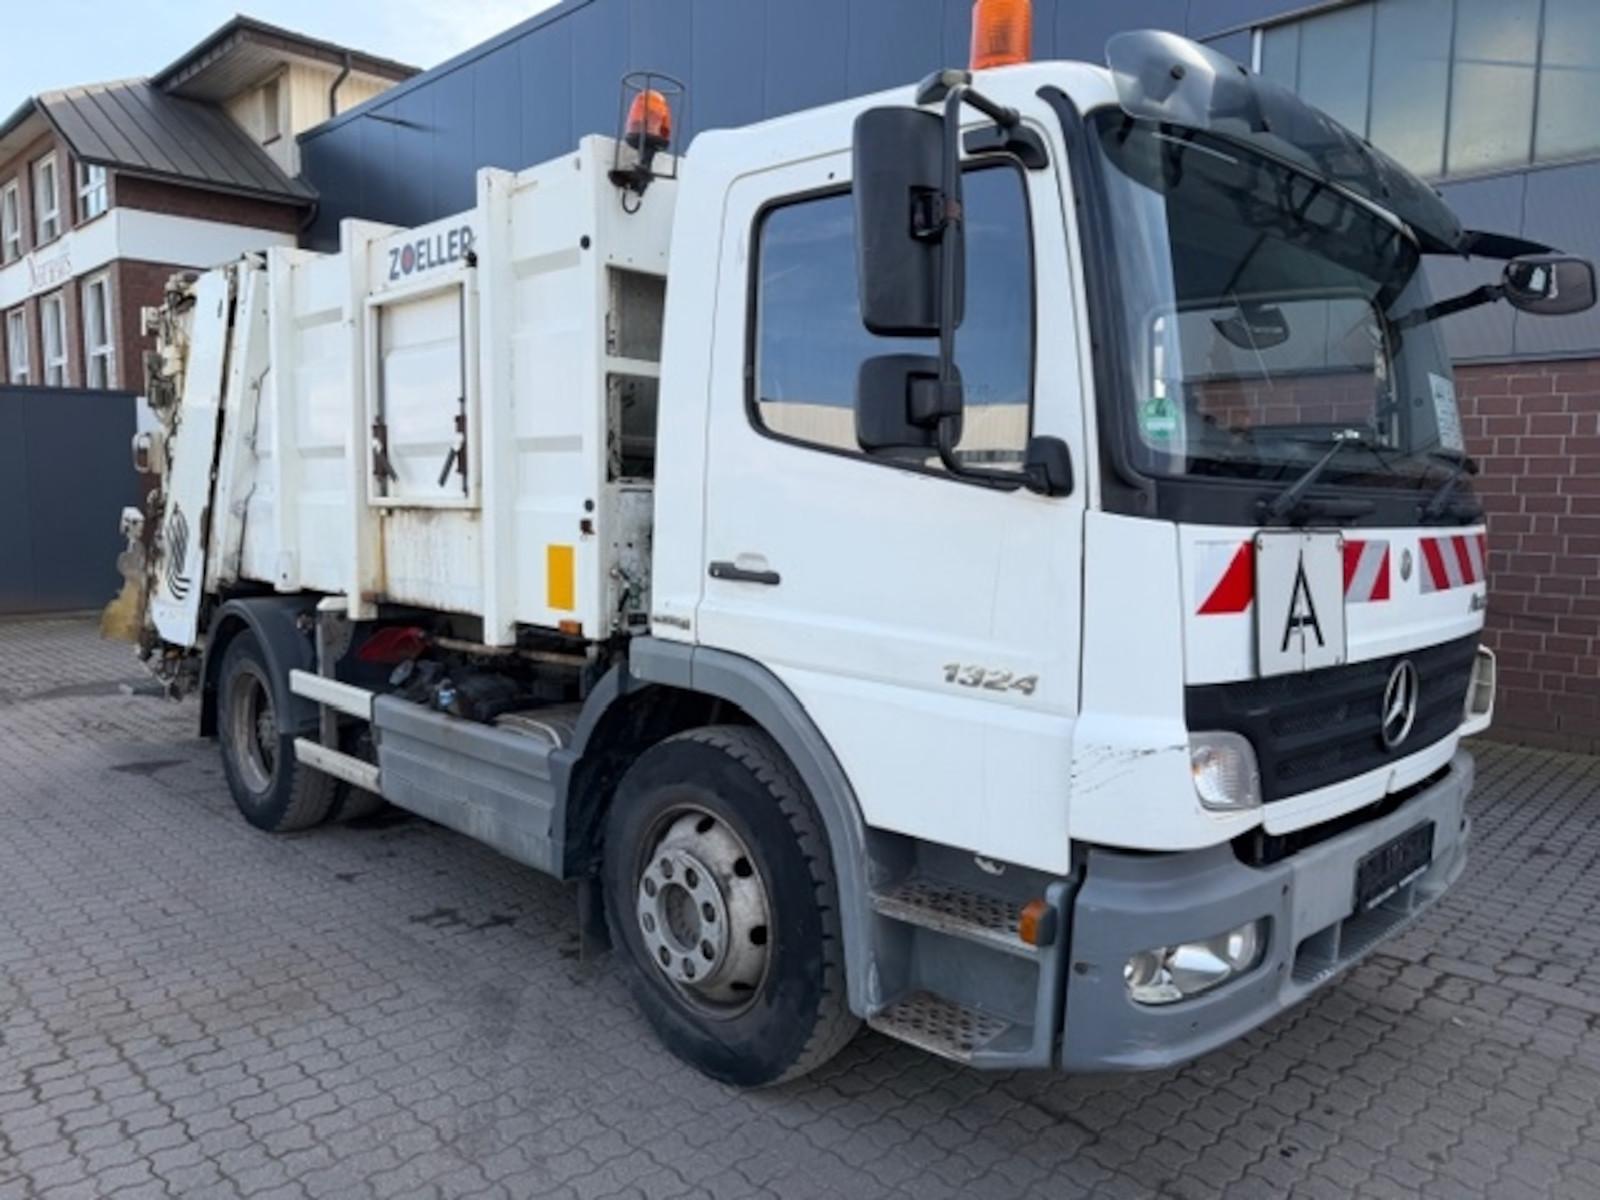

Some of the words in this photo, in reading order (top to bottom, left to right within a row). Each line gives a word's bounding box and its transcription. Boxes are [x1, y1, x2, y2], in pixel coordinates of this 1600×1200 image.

[389, 225, 474, 281] ZOELLER
[1281, 548, 1325, 652] A
[943, 662, 1039, 696] 1324
